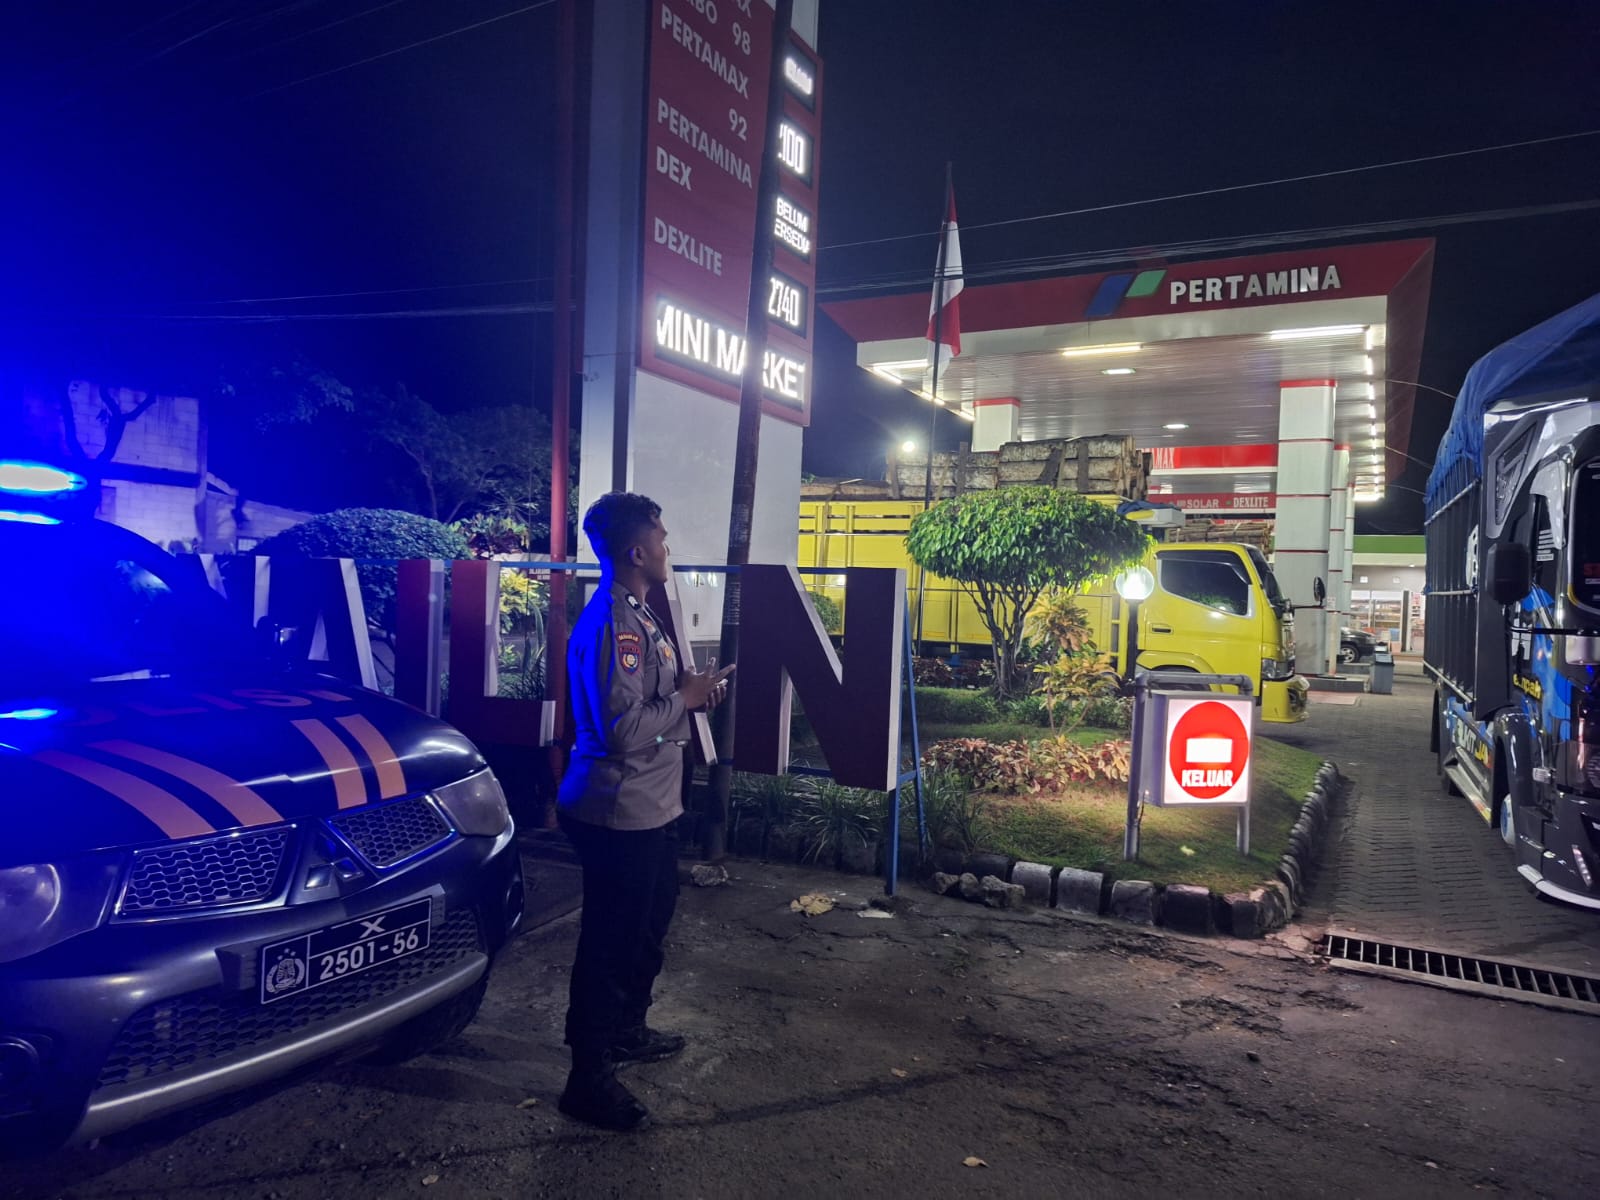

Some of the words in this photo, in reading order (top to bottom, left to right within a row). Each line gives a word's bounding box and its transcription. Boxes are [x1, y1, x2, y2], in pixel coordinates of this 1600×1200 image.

[661, 3, 749, 99] PERTAMAX
[732, 22, 751, 55] 98
[657, 98, 753, 189] PERTAMINA
[729, 108, 748, 141] 92
[656, 146, 692, 191] DEX
[776, 196, 809, 233] BELUM
[654, 217, 722, 277] DEXLITE
[1170, 264, 1342, 305] PERTAMINA
[656, 304, 710, 362] MINI
[1233, 497, 1269, 508] DEXLITE
[1181, 769, 1234, 787] KELUAR
[359, 915, 386, 938] X
[319, 928, 419, 980] 2501-56
